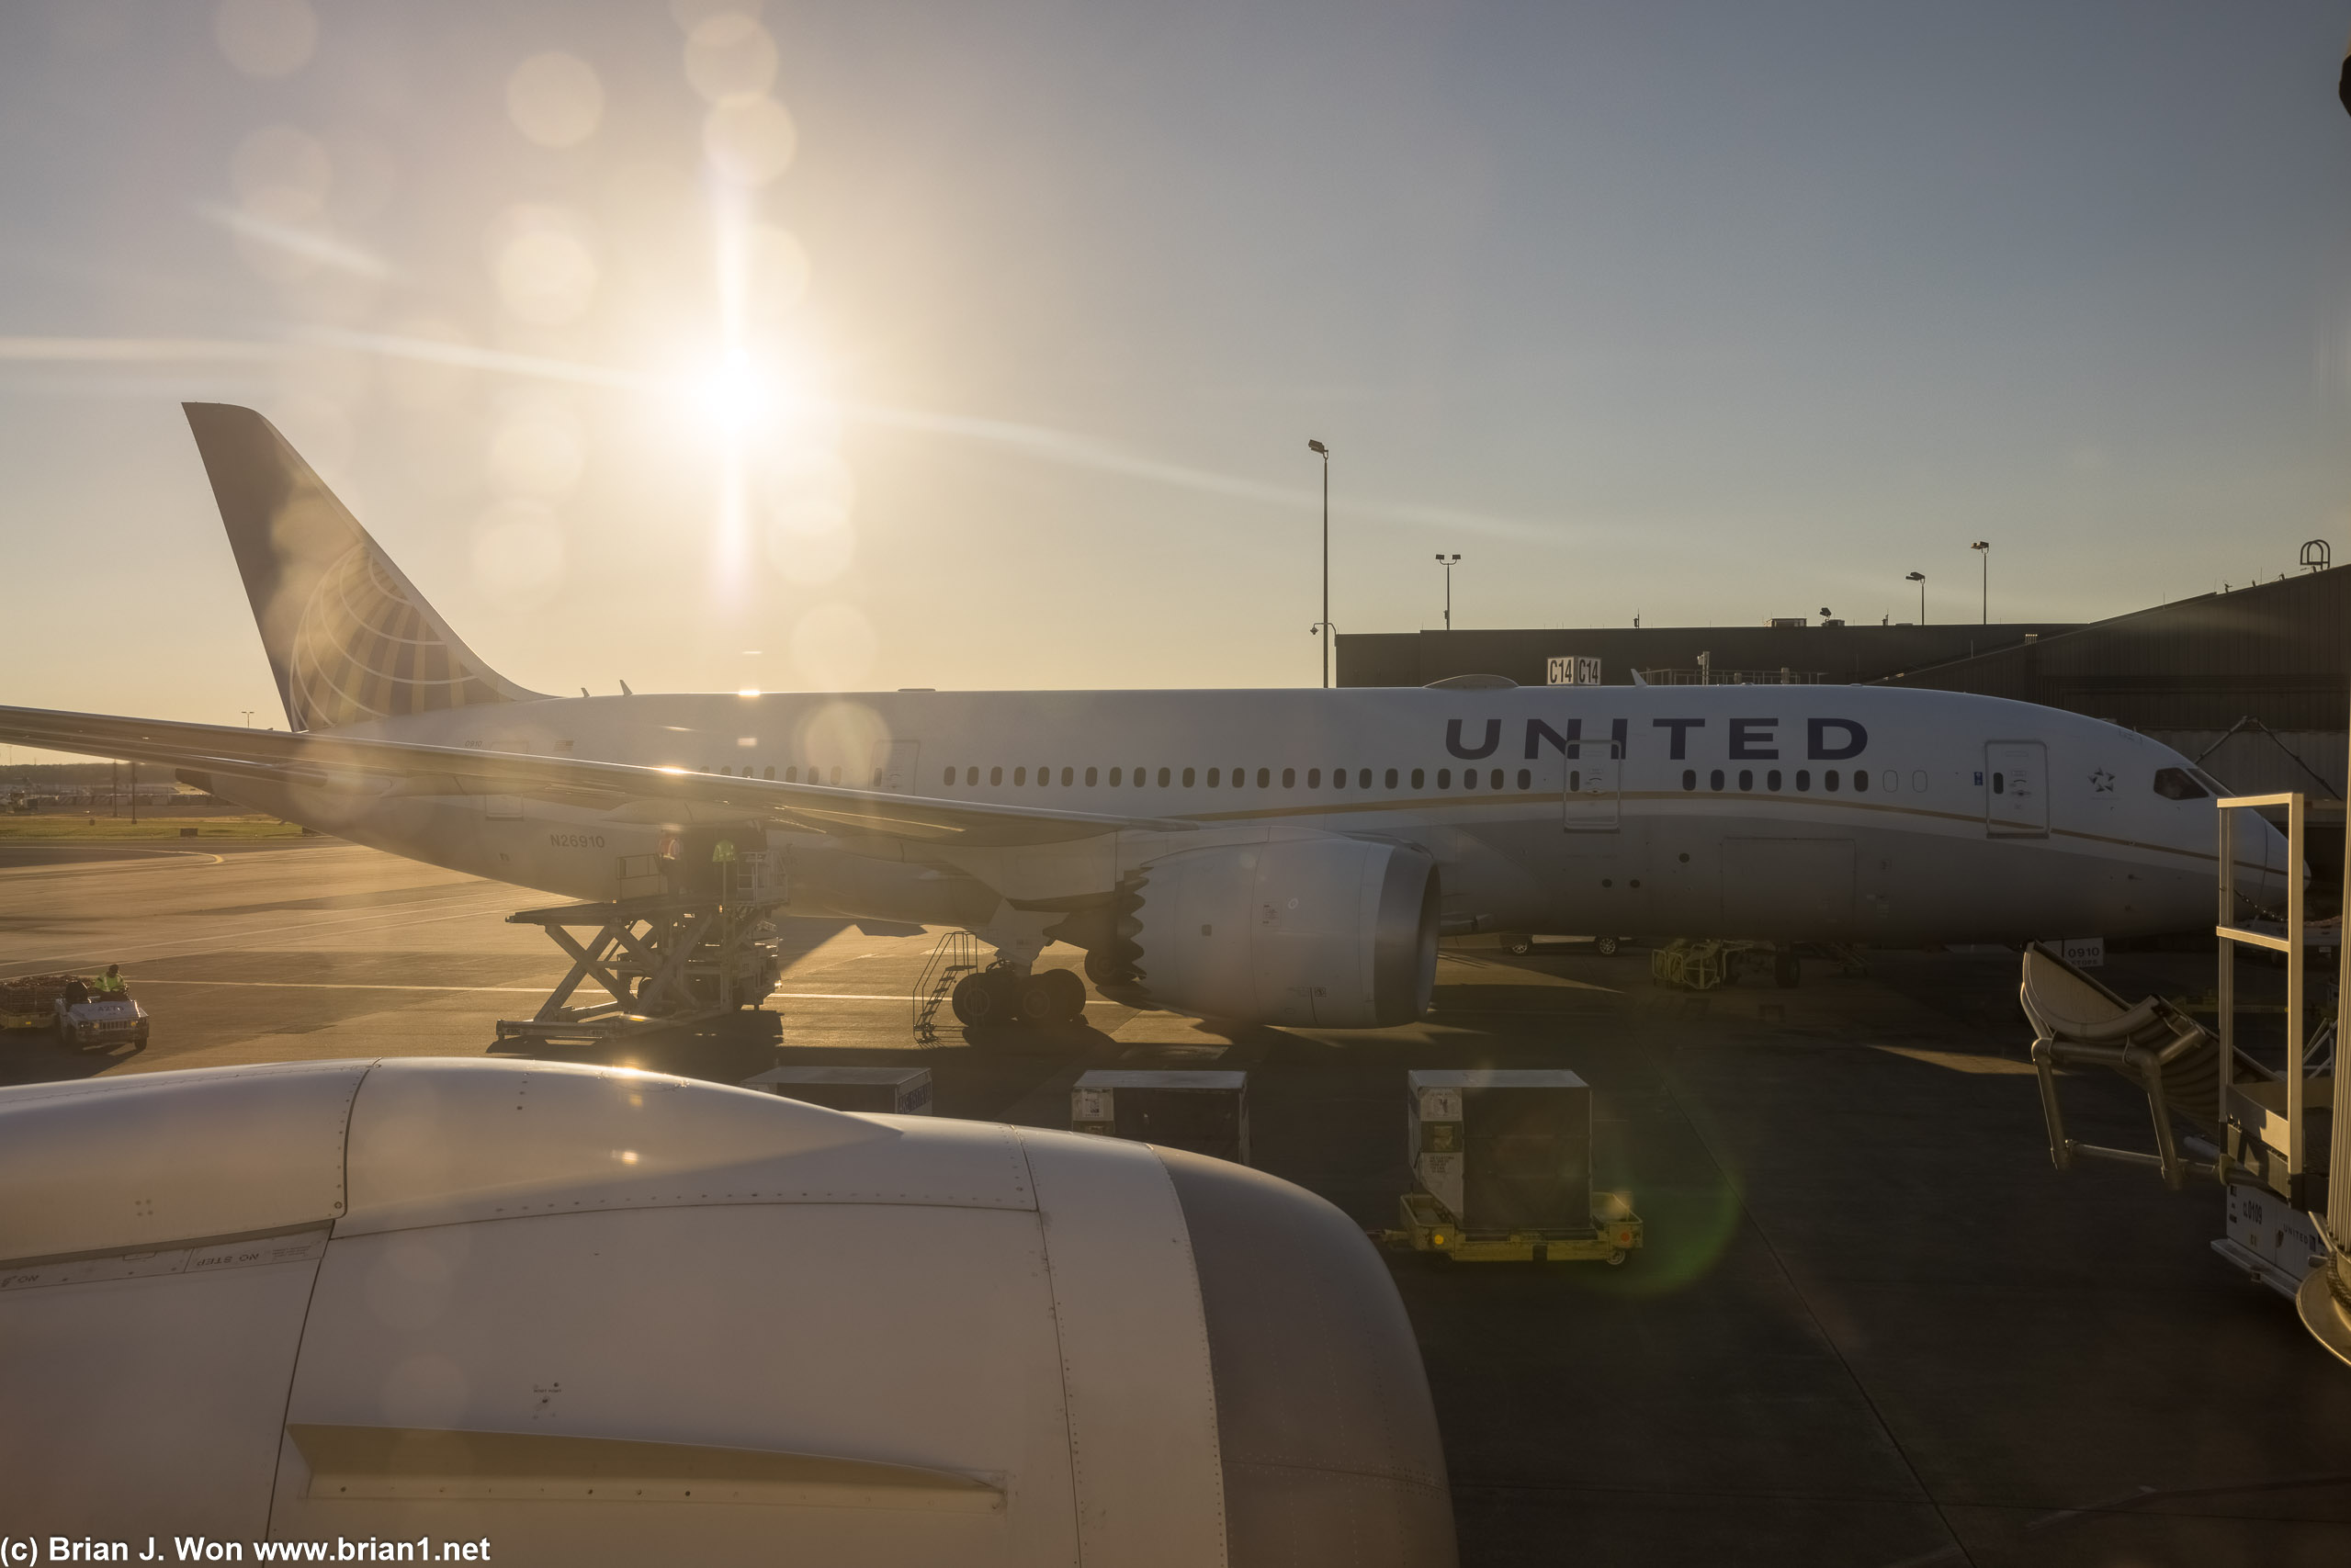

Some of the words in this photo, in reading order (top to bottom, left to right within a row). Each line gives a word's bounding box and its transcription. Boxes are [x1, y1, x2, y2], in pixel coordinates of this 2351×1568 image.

[1550, 660, 1572, 683] C14
[1579, 659, 1599, 683] C14
[1445, 718, 1869, 760] UNITED
[550, 834, 605, 848] N26910
[2068, 947, 2099, 958] 0910
[2283, 1223, 2308, 1245] UNITED
[197, 1256, 232, 1266] STEP
[239, 1253, 260, 1262] NO
[17, 1275, 40, 1283] NO
